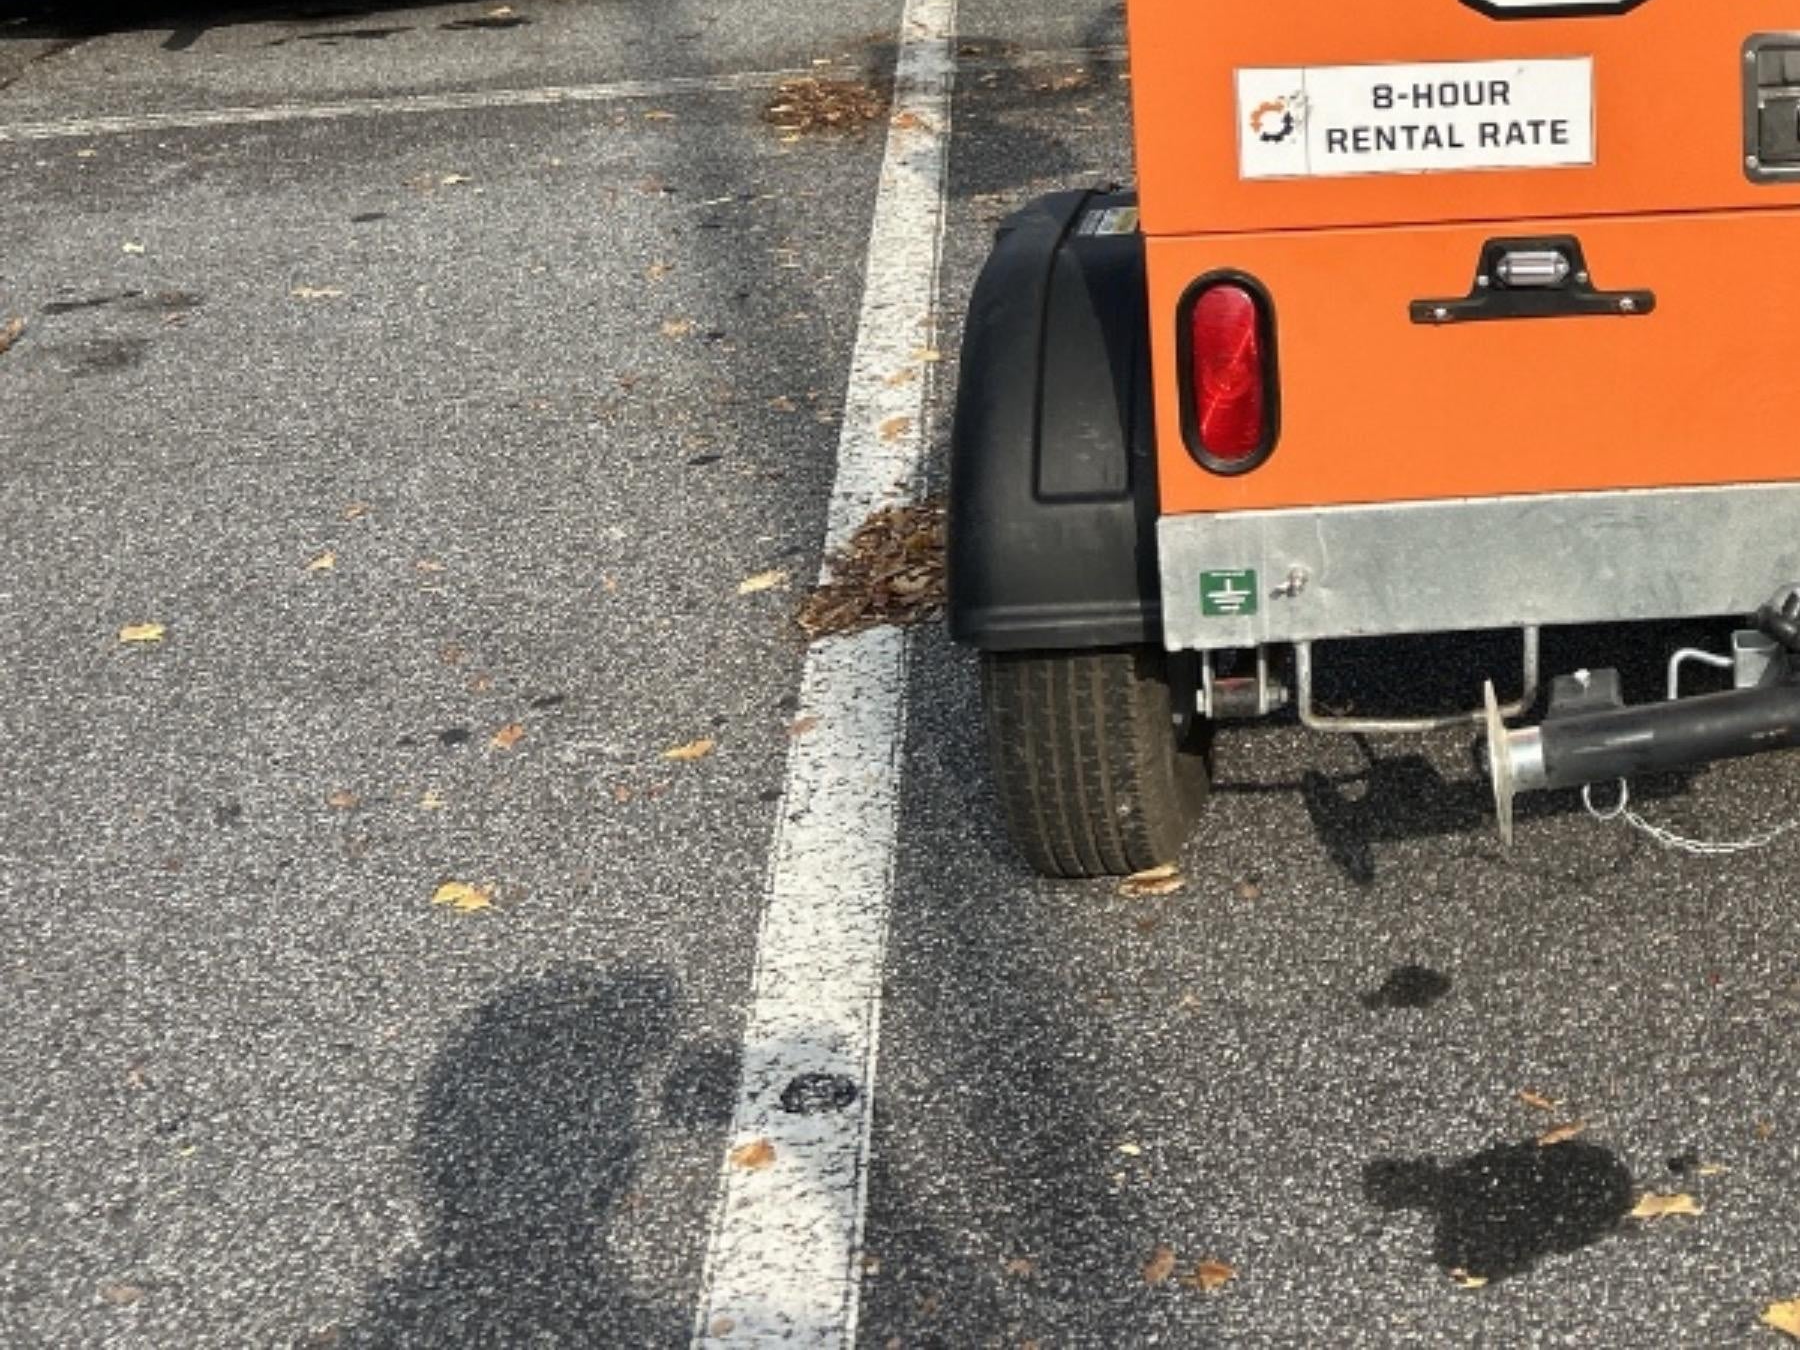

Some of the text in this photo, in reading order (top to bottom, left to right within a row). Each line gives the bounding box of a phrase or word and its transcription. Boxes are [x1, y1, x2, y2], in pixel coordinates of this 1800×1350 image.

[1372, 79, 1512, 111] 8-HOUR
[1326, 118, 1571, 155] RENTAL RATE
